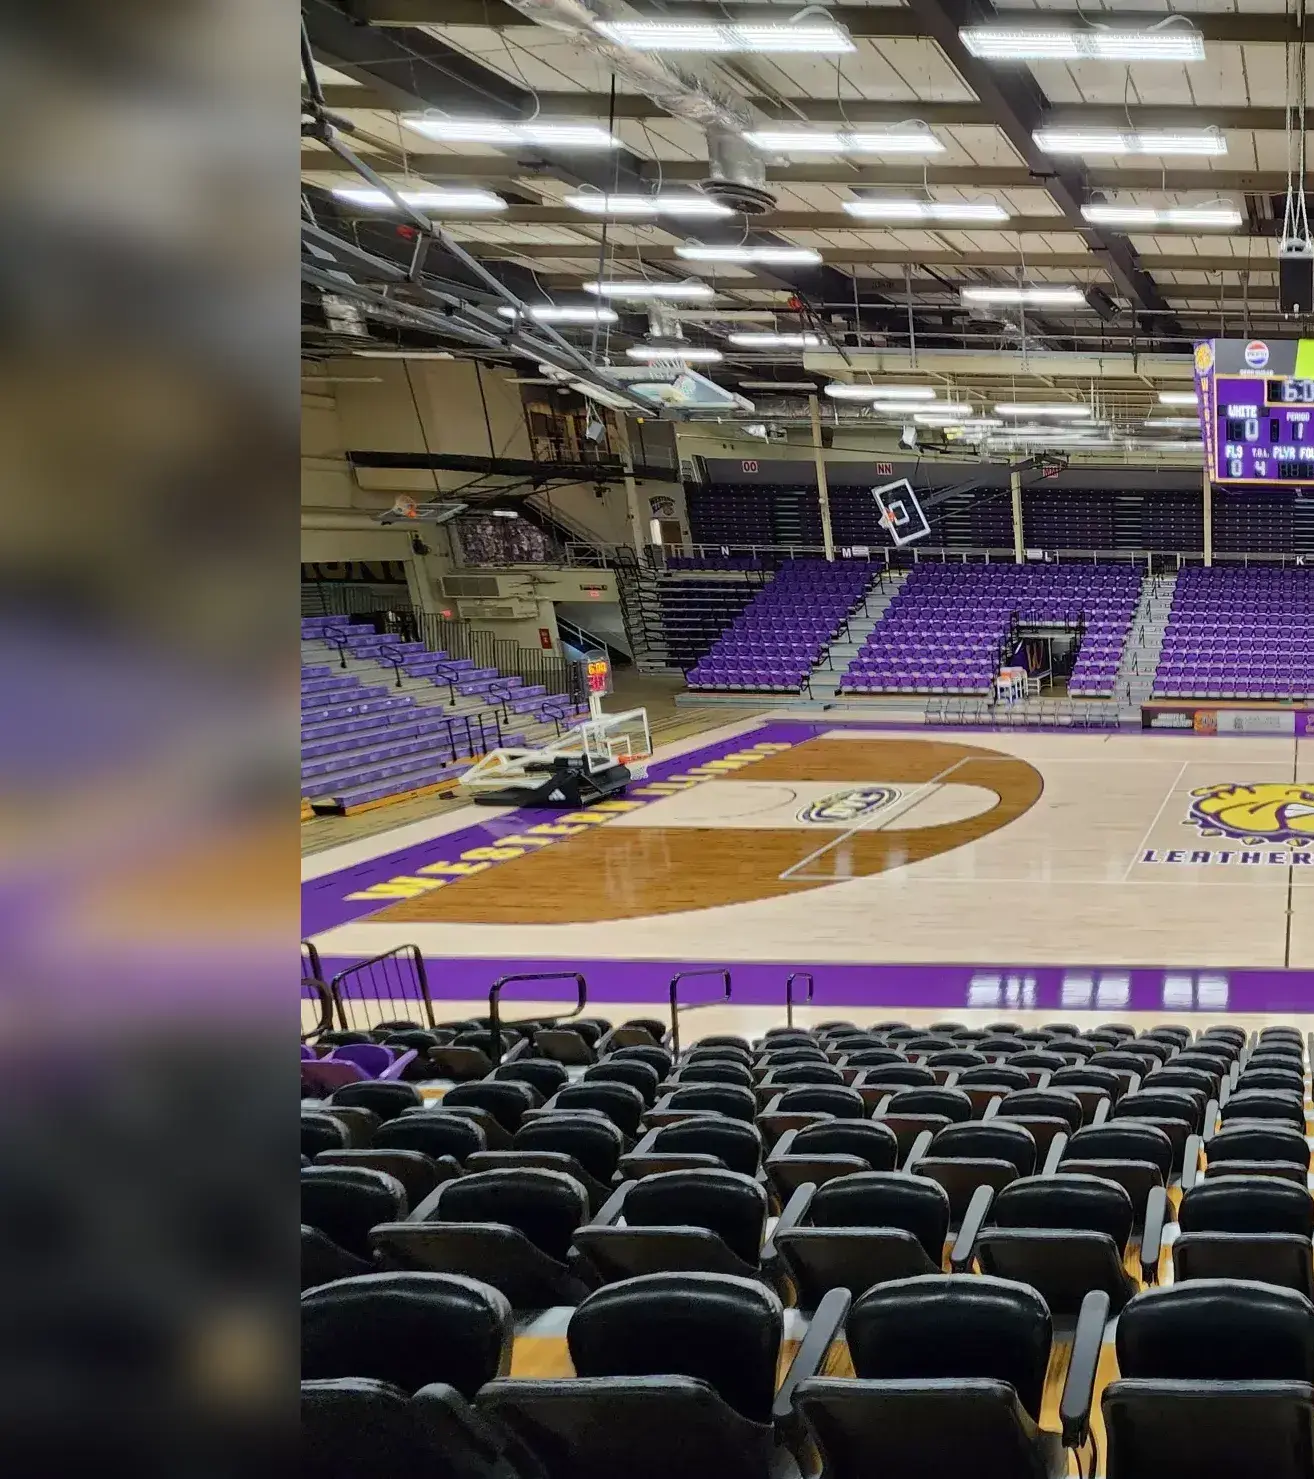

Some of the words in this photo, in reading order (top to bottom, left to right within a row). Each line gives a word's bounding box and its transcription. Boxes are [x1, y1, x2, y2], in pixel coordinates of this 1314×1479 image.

[1228, 405, 1258, 418] WHITE
[1286, 411, 1310, 422] PERIOD
[1245, 419, 1259, 441] 0
[1297, 422, 1304, 440] 1
[1225, 445, 1243, 459] FLS
[1272, 445, 1296, 460] PLYR
[878, 463, 891, 474] NN
[1231, 460, 1243, 477] 0
[1255, 460, 1266, 477] 4
[721, 546, 730, 556] N
[842, 547, 852, 558] M
[1045, 551, 1053, 562] L
[1295, 555, 1304, 566] K
[588, 661, 607, 675] 6:00
[344, 801, 647, 902] WESTERN
